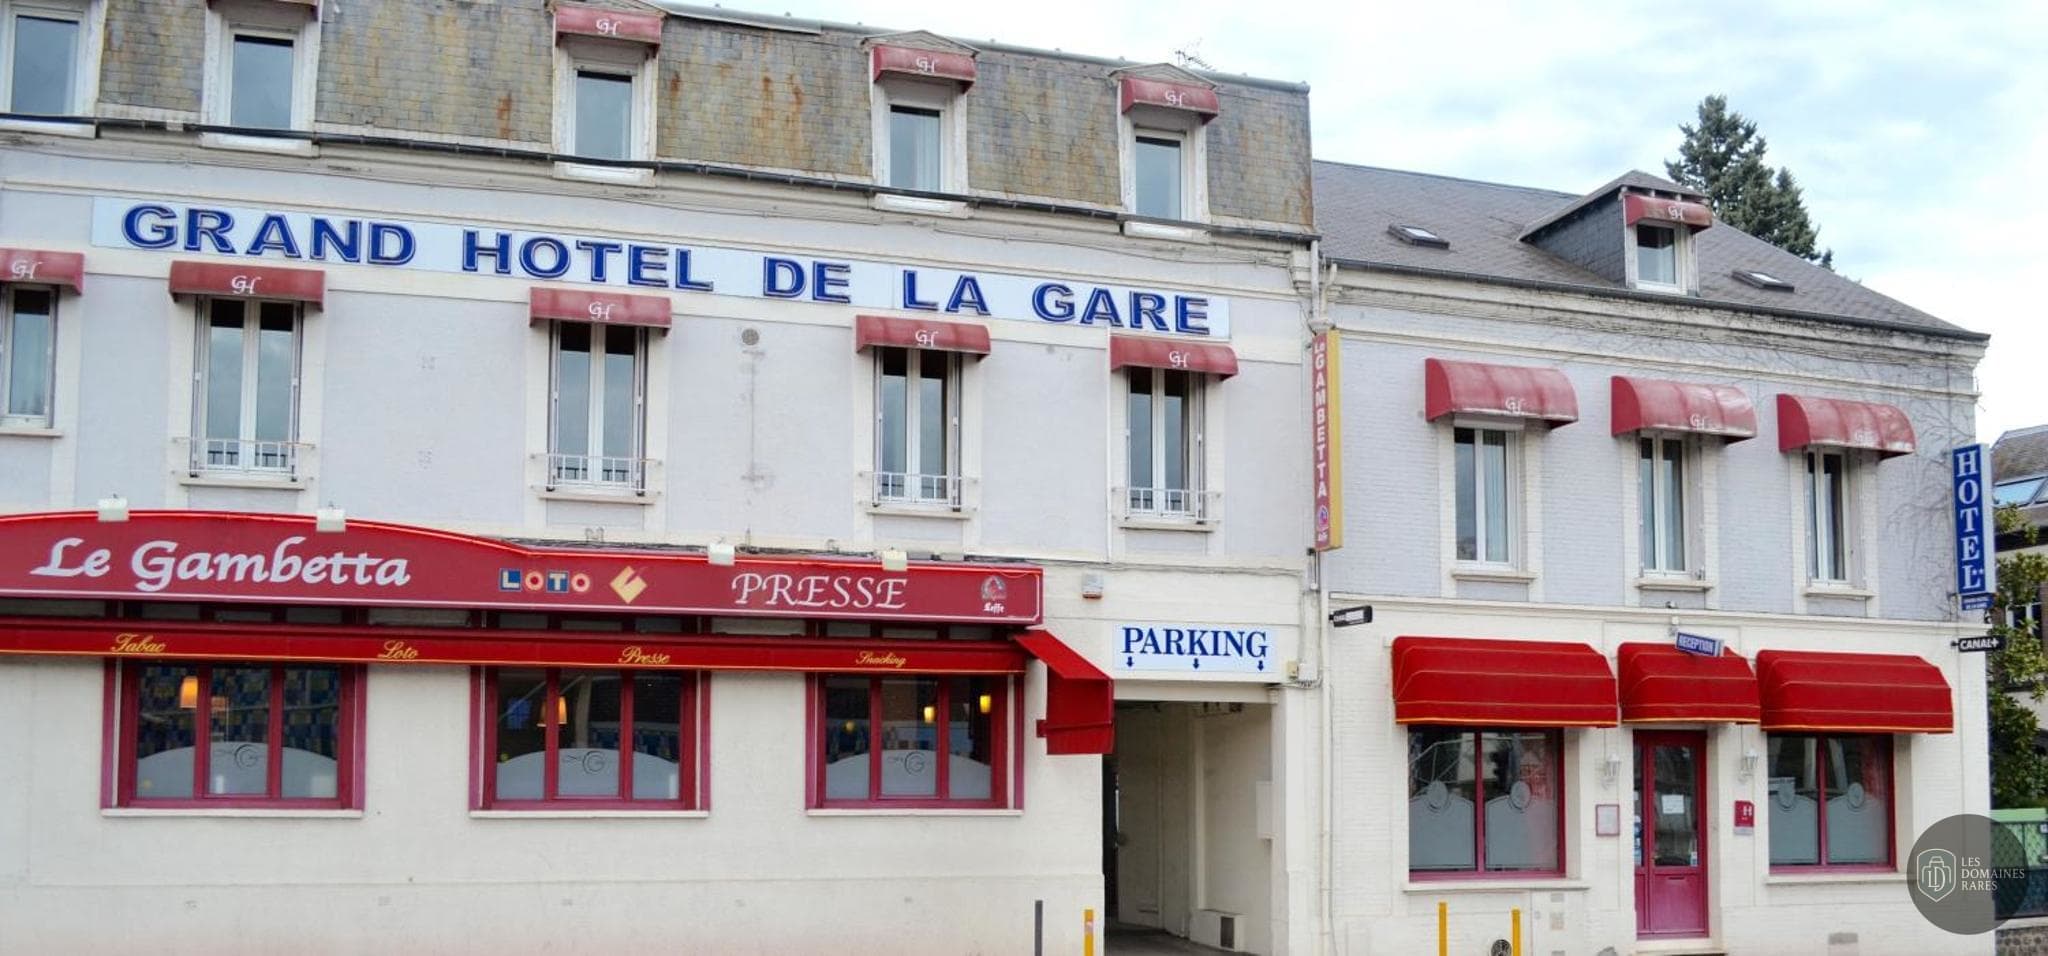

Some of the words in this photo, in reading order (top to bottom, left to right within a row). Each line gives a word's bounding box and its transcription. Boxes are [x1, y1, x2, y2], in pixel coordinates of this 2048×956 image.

[122, 203, 416, 266] GRAND
[462, 230, 714, 291] HOTEL
[763, 256, 851, 304] DE
[903, 269, 991, 316] LA
[1032, 283, 1210, 336] GARE
[1314, 353, 1328, 498] GAMBETTA
[1956, 450, 1981, 590] HOTEL
[30, 537, 110, 578] Le
[131, 536, 411, 592] Gambetta
[499, 567, 592, 593] LOTO
[731, 573, 908, 609] PRESSE
[111, 633, 166, 653] Tabac
[377, 640, 418, 660] Loto
[618, 646, 670, 665] Presse
[1122, 625, 1268, 659] PARKING
[1960, 637, 1999, 650] CANAL+
[855, 650, 906, 668] Snacking
